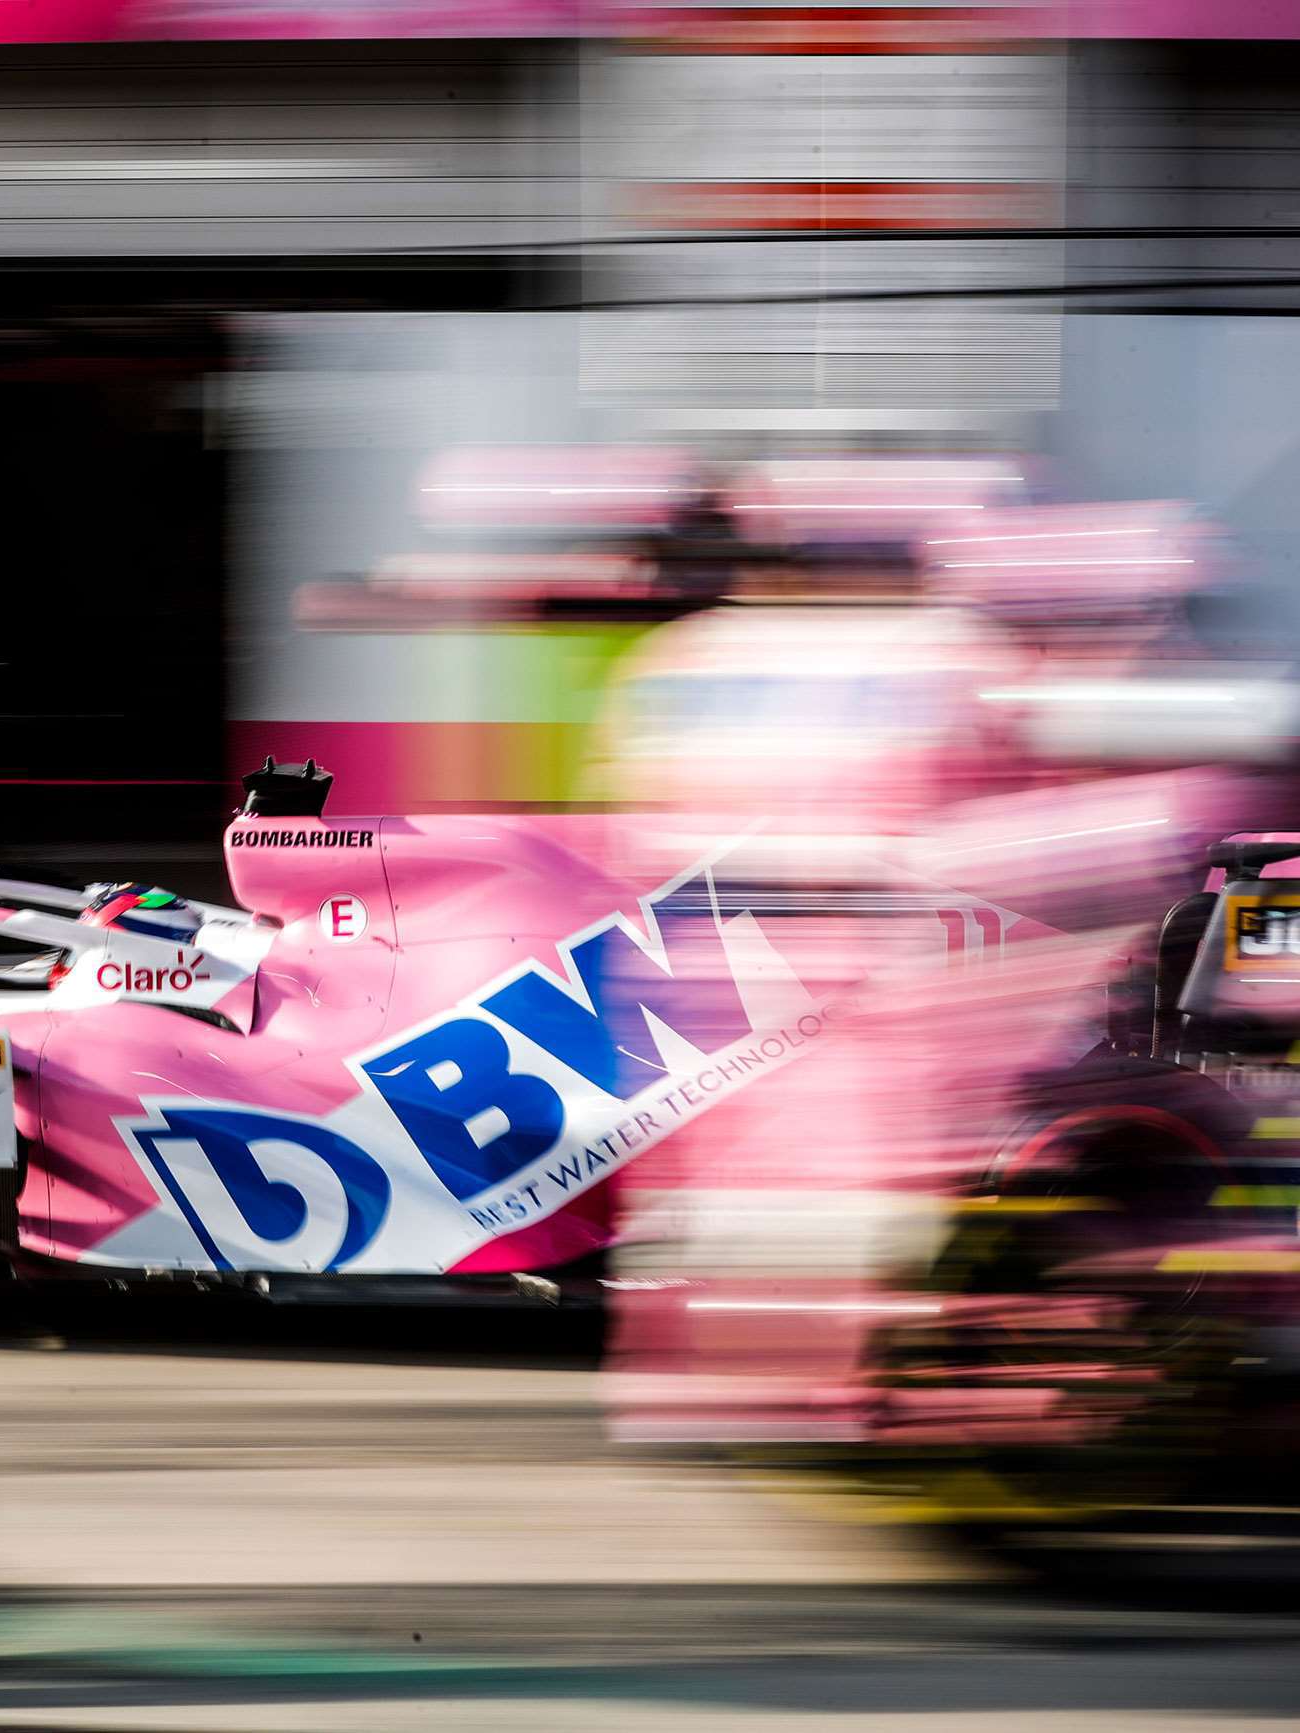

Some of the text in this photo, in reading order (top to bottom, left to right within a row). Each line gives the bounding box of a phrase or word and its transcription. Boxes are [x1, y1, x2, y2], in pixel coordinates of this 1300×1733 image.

[231, 830, 374, 848] BOMBARDIER
[331, 900, 353, 936] E
[97, 959, 193, 992] Claro
[467, 1178, 542, 1230] BEST
[545, 1111, 662, 1191] WATER
